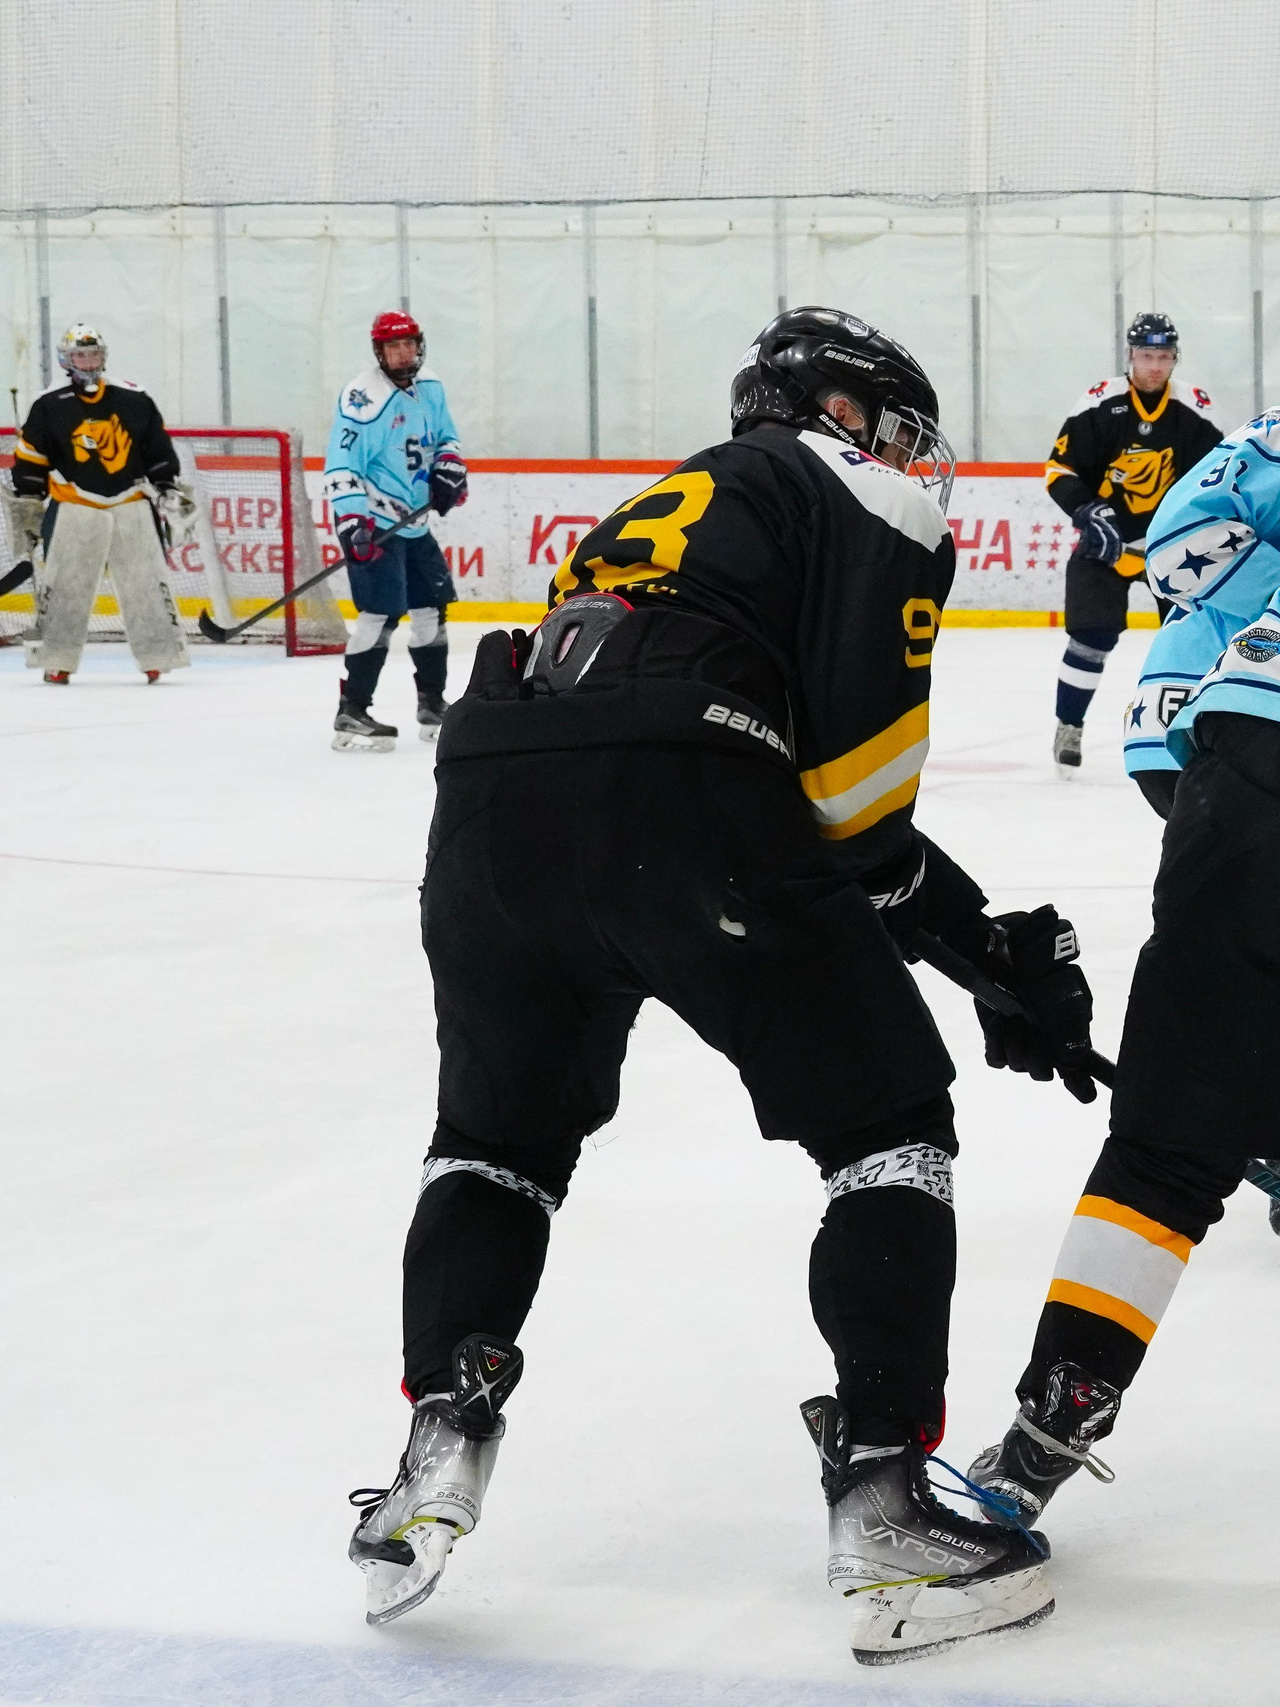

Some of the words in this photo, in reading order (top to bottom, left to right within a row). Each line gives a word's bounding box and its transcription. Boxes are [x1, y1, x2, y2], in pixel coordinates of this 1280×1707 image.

[823, 349, 876, 371] BAUER
[339, 428, 358, 451] 27
[818, 413, 856, 446] BAUER
[553, 470, 716, 600] 3
[902, 597, 942, 669] 9
[702, 703, 793, 761] BAUER
[859, 1516, 971, 1574] VAPOR
[928, 1528, 987, 1556] BAUER
